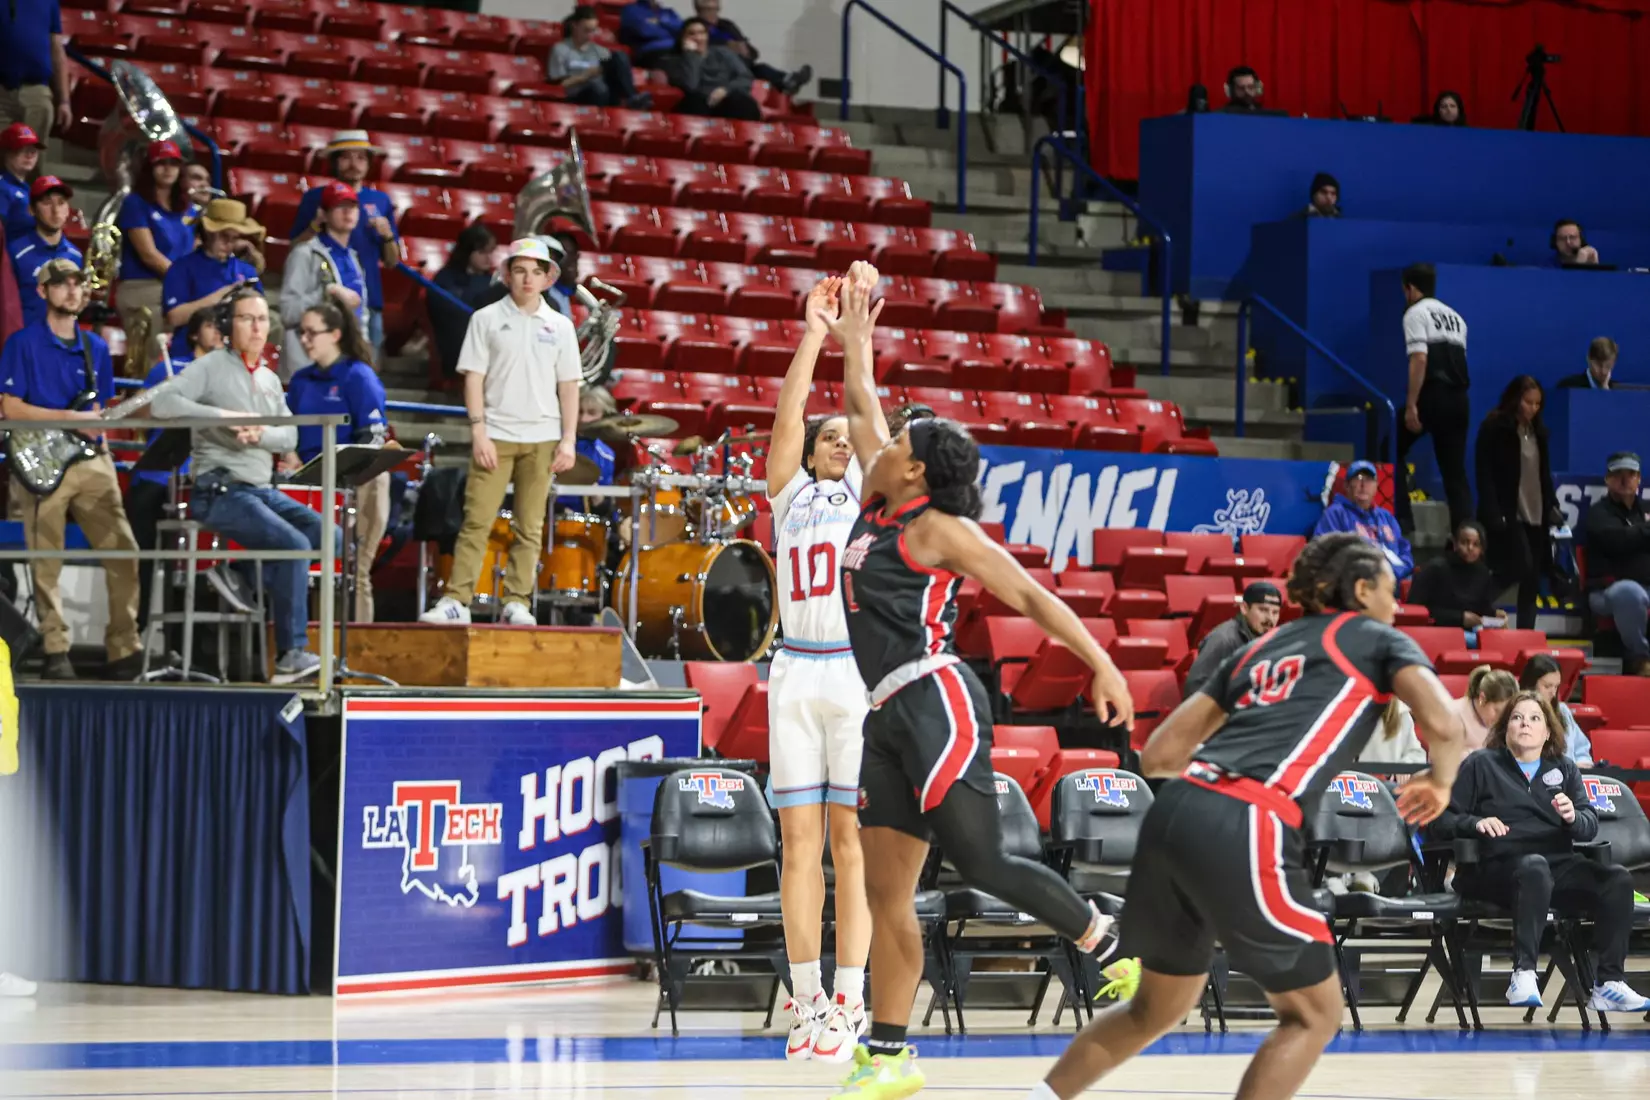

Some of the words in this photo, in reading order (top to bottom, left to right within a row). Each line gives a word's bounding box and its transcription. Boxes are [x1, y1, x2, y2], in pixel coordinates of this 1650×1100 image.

[789, 542, 836, 602] 10
[1234, 654, 1306, 709] 10
[362, 804, 409, 848] LA
[497, 842, 623, 947] TRO
